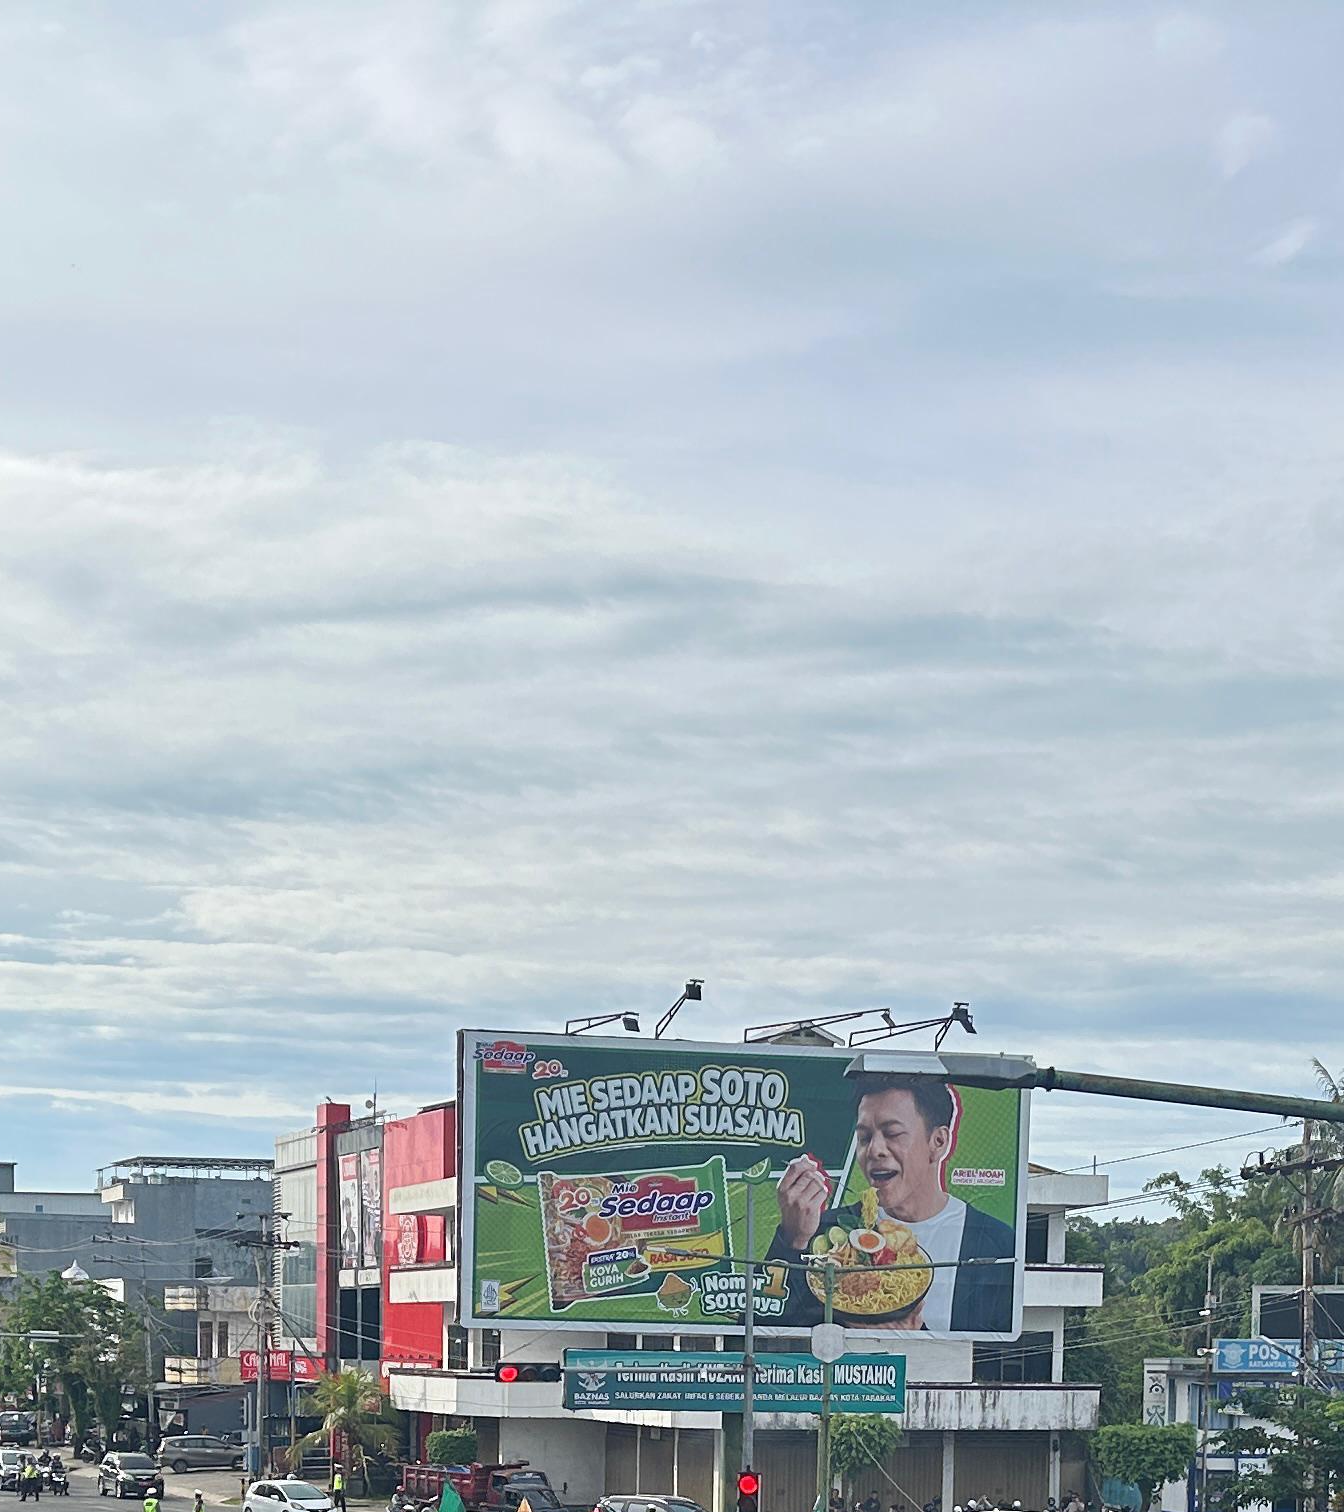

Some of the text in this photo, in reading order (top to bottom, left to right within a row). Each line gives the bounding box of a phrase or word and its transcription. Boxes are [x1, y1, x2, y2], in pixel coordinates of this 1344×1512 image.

[537, 1069, 786, 1121] MIE SEDAAP SOTO
[523, 1104, 802, 1156] HANGATKAN SUASANA
[953, 1169, 1003, 1178] ARIEL NOAH
[611, 1183, 638, 1194] Mie
[599, 1190, 715, 1218] Sedaap
[653, 1211, 690, 1223] Instant
[590, 1264, 617, 1277] KOYA
[590, 1273, 624, 1288] GURIH
[705, 1273, 764, 1291] Nomr
[1249, 1344, 1281, 1360] POS
[798, 1364, 824, 1384] Kasi
[834, 1365, 896, 1388] MUSTAHIQ
[574, 1392, 610, 1400] BAZNAS
